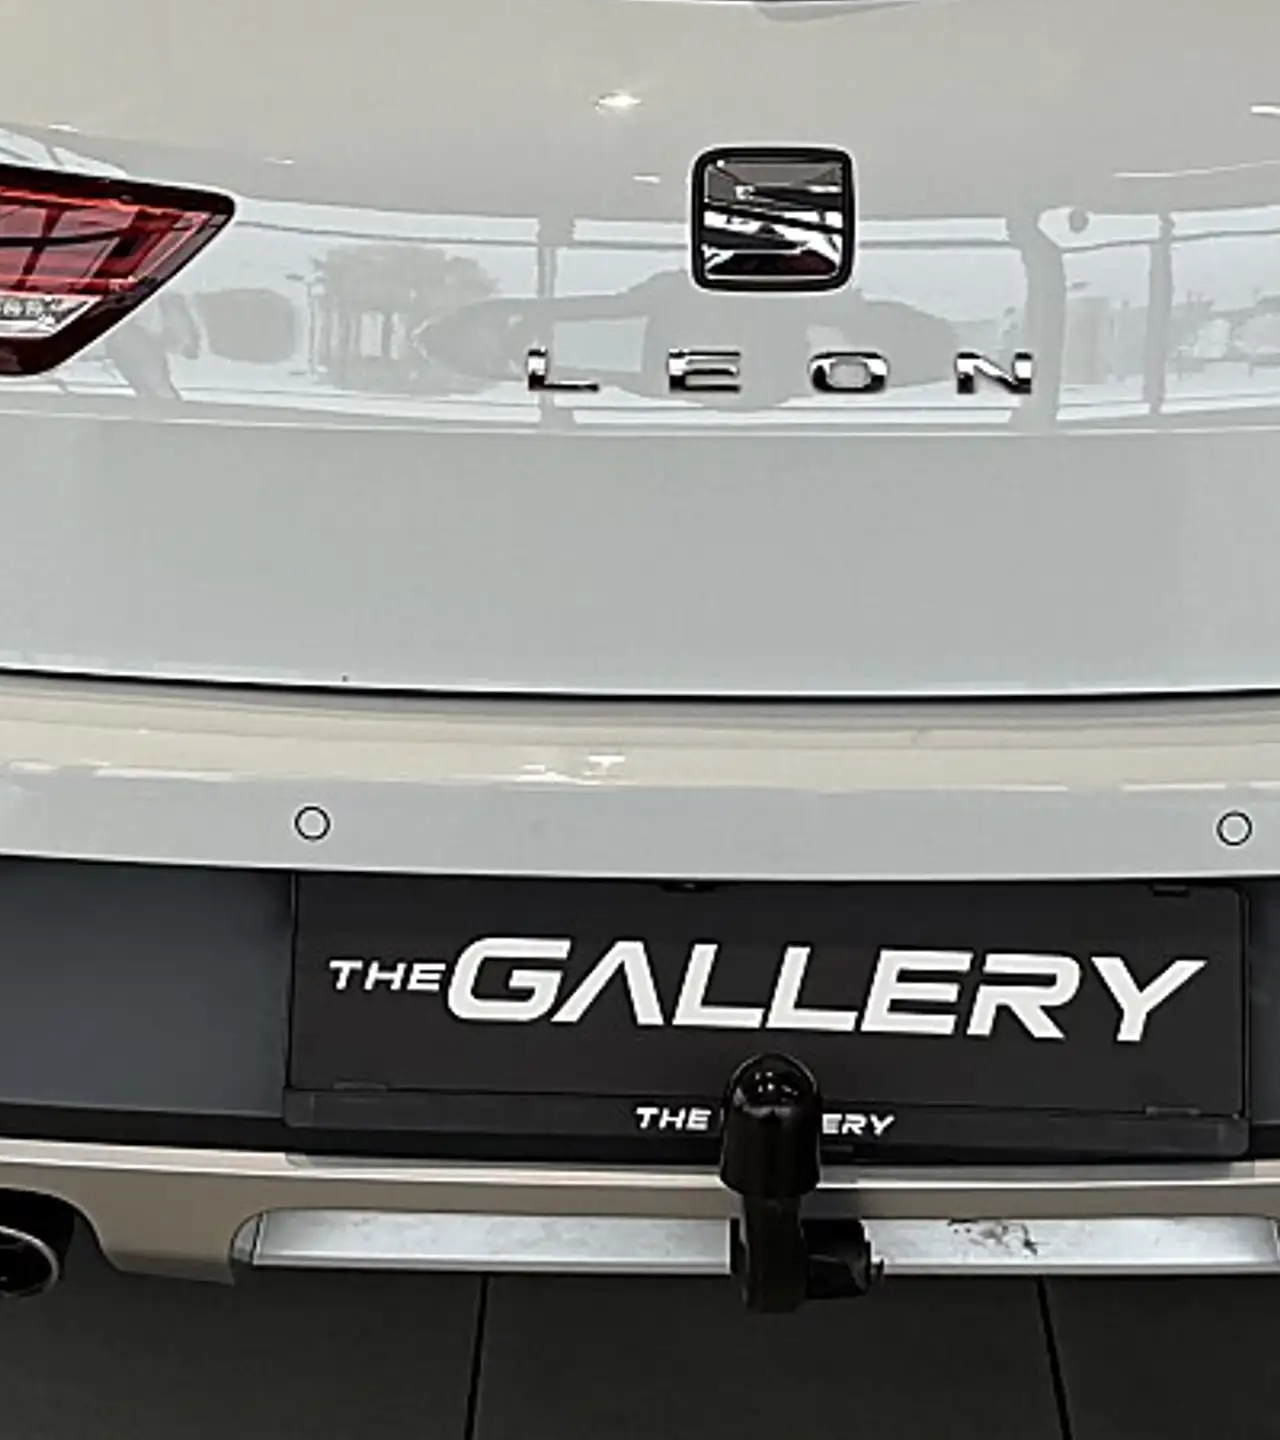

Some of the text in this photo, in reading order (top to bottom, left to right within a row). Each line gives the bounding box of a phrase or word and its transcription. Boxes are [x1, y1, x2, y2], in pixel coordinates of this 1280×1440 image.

[526, 346, 1034, 396] LEON
[327, 935, 1208, 1044] THE GALLERY
[634, 1106, 713, 1131] THE
